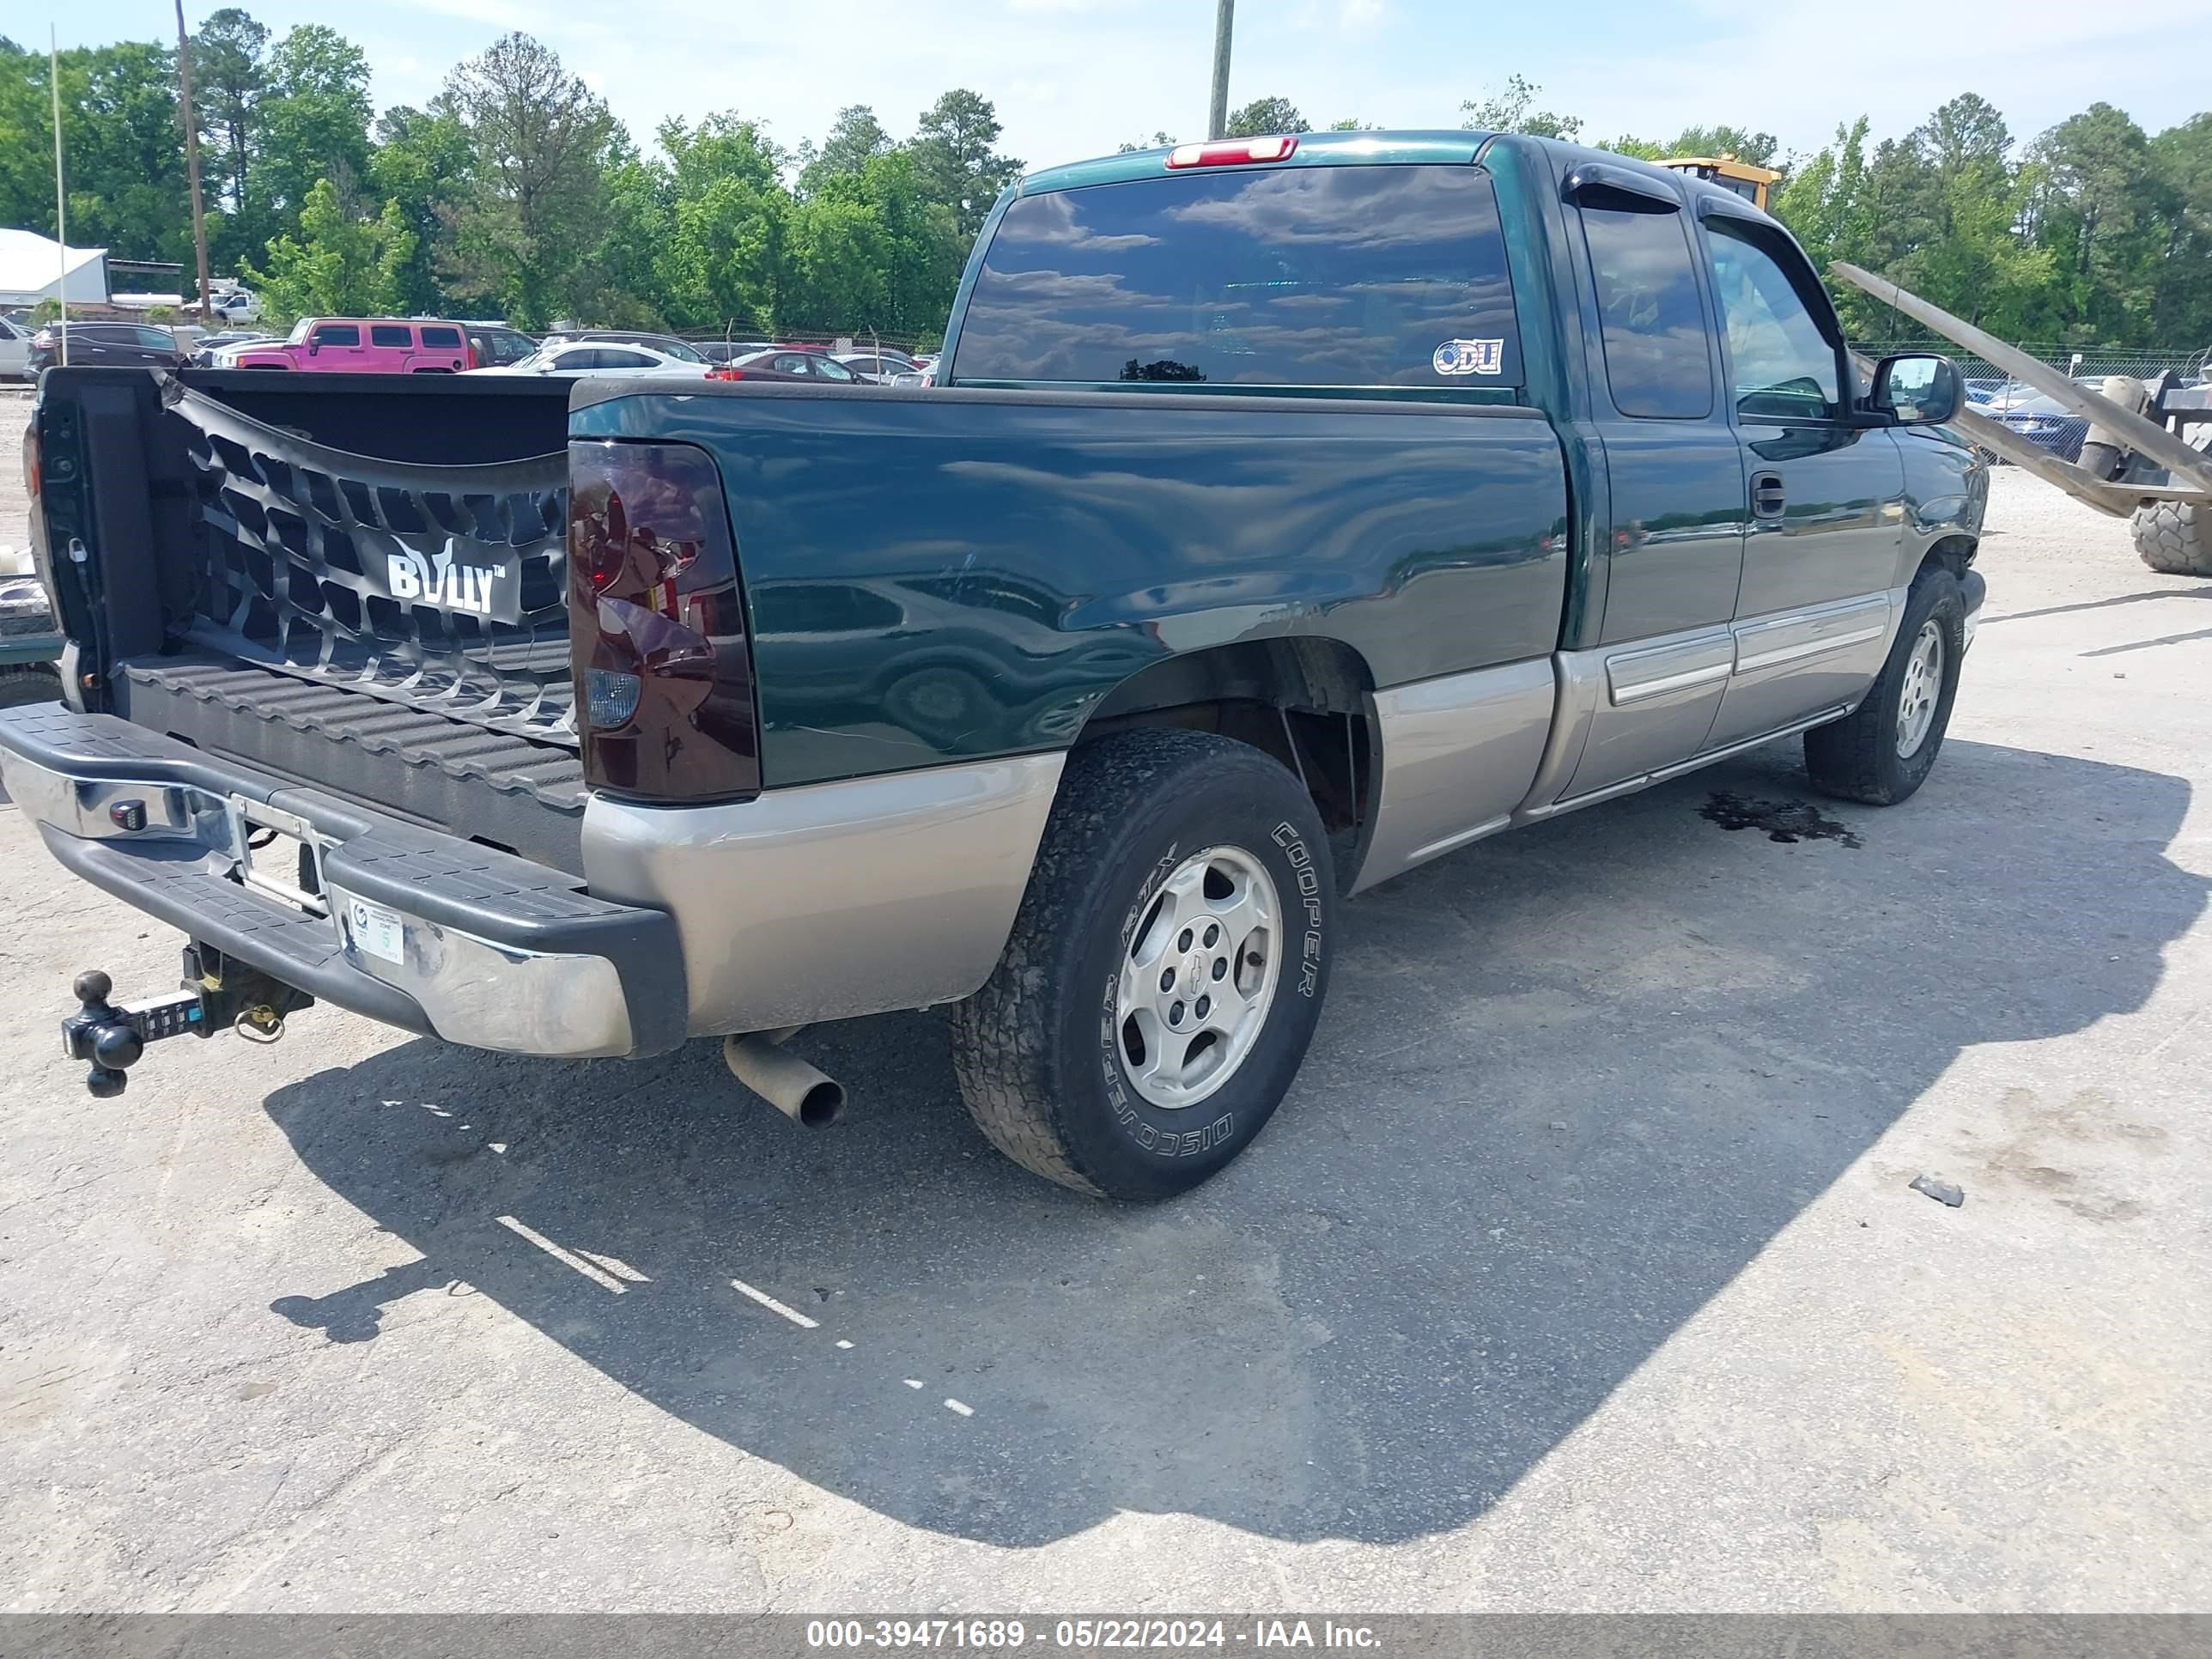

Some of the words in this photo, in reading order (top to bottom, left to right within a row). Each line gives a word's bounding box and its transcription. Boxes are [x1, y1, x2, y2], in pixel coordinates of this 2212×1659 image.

[1435, 341, 1502, 373] ODU
[387, 534, 493, 614] BULLY
[1271, 821, 1322, 998] COOPER
[1100, 974, 1233, 1158] DISCOVERER
